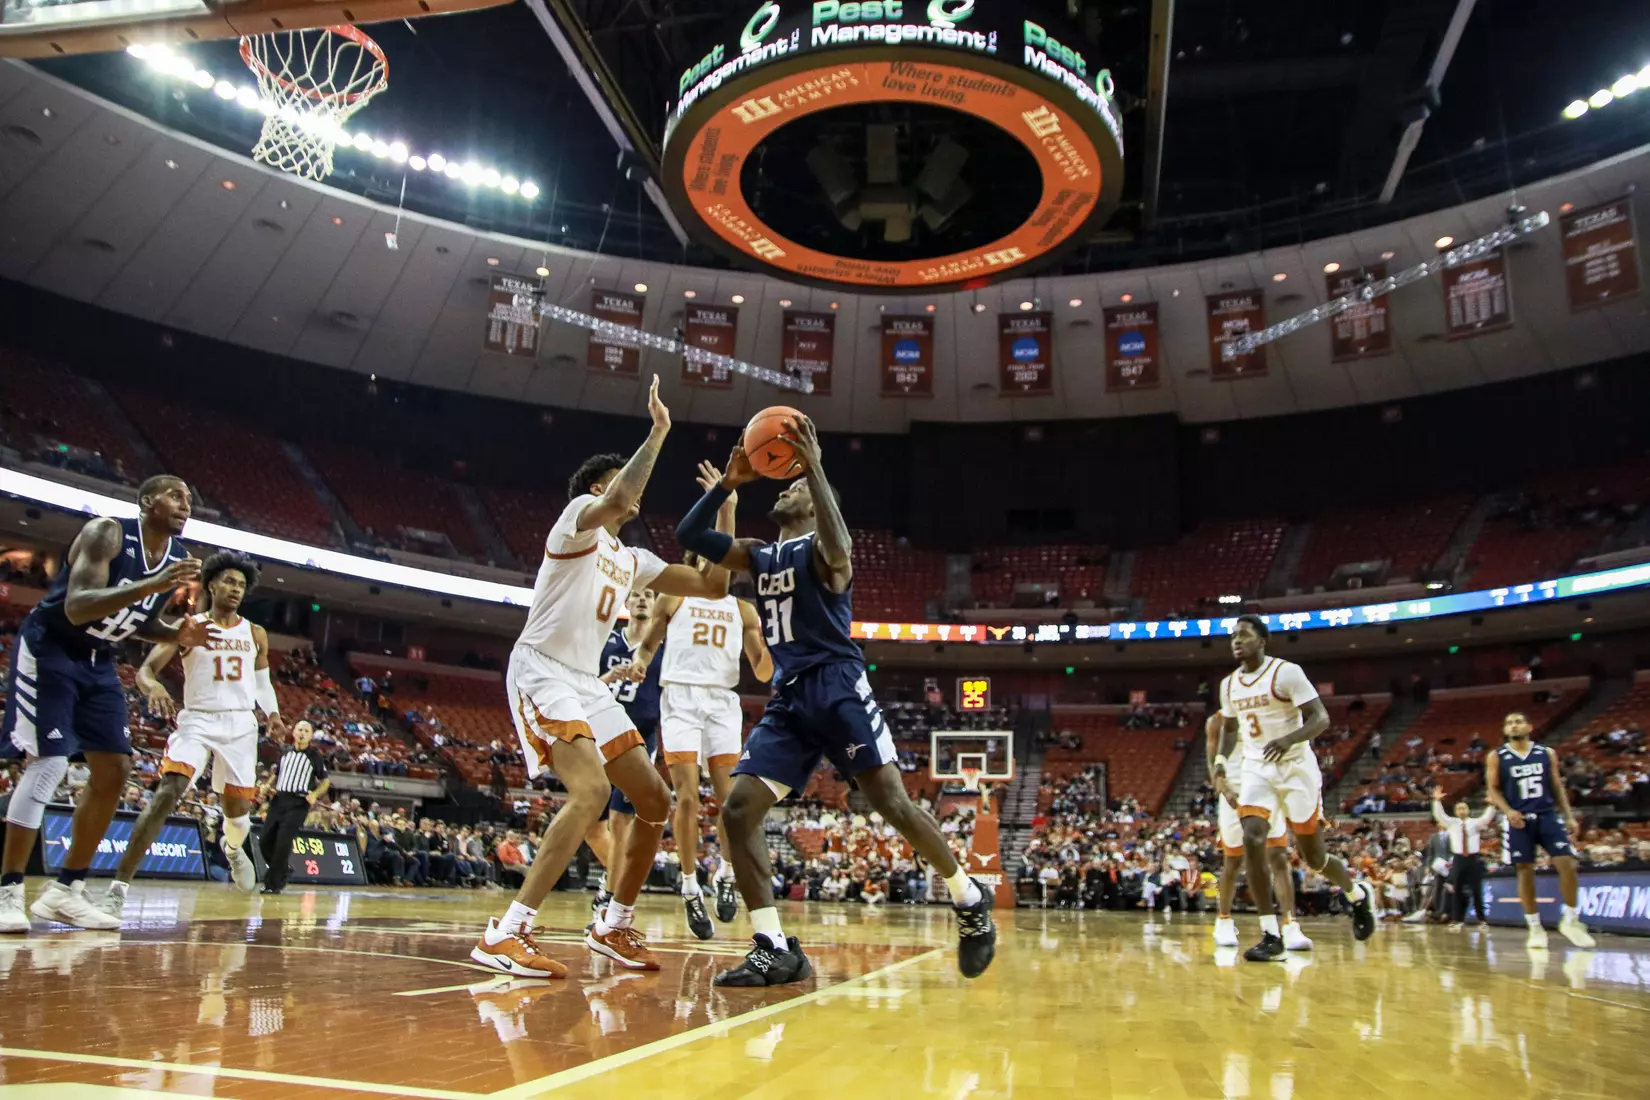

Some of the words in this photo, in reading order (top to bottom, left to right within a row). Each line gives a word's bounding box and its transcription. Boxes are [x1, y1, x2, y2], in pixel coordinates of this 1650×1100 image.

[812, 0, 903, 26] Pest
[811, 24, 987, 50] Management
[1024, 19, 1087, 78] Pest
[677, 37, 789, 119] Management
[679, 43, 725, 98] Pest
[777, 67, 852, 101] AMERICAN
[889, 61, 943, 83] Where
[947, 74, 1017, 98] students
[783, 75, 860, 110] CAMPUS
[882, 75, 917, 93] love
[920, 81, 967, 104] living
[597, 554, 631, 587] TEXAS
[758, 567, 796, 596] CBU
[596, 584, 617, 624] 0
[688, 606, 734, 623] TEXAS
[86, 607, 149, 642] 35
[764, 596, 796, 647] 31
[692, 622, 727, 649] 20
[213, 655, 243, 682] 13
[1232, 694, 1271, 712] TEXAS
[1246, 712, 1263, 739] 3
[1510, 763, 1544, 778] CBU
[1517, 776, 1544, 800] 15
[152, 842, 187, 858] RESORT
[292, 837, 325, 856] 16:58
[304, 860, 320, 875] 25
[340, 860, 355, 875] 22
